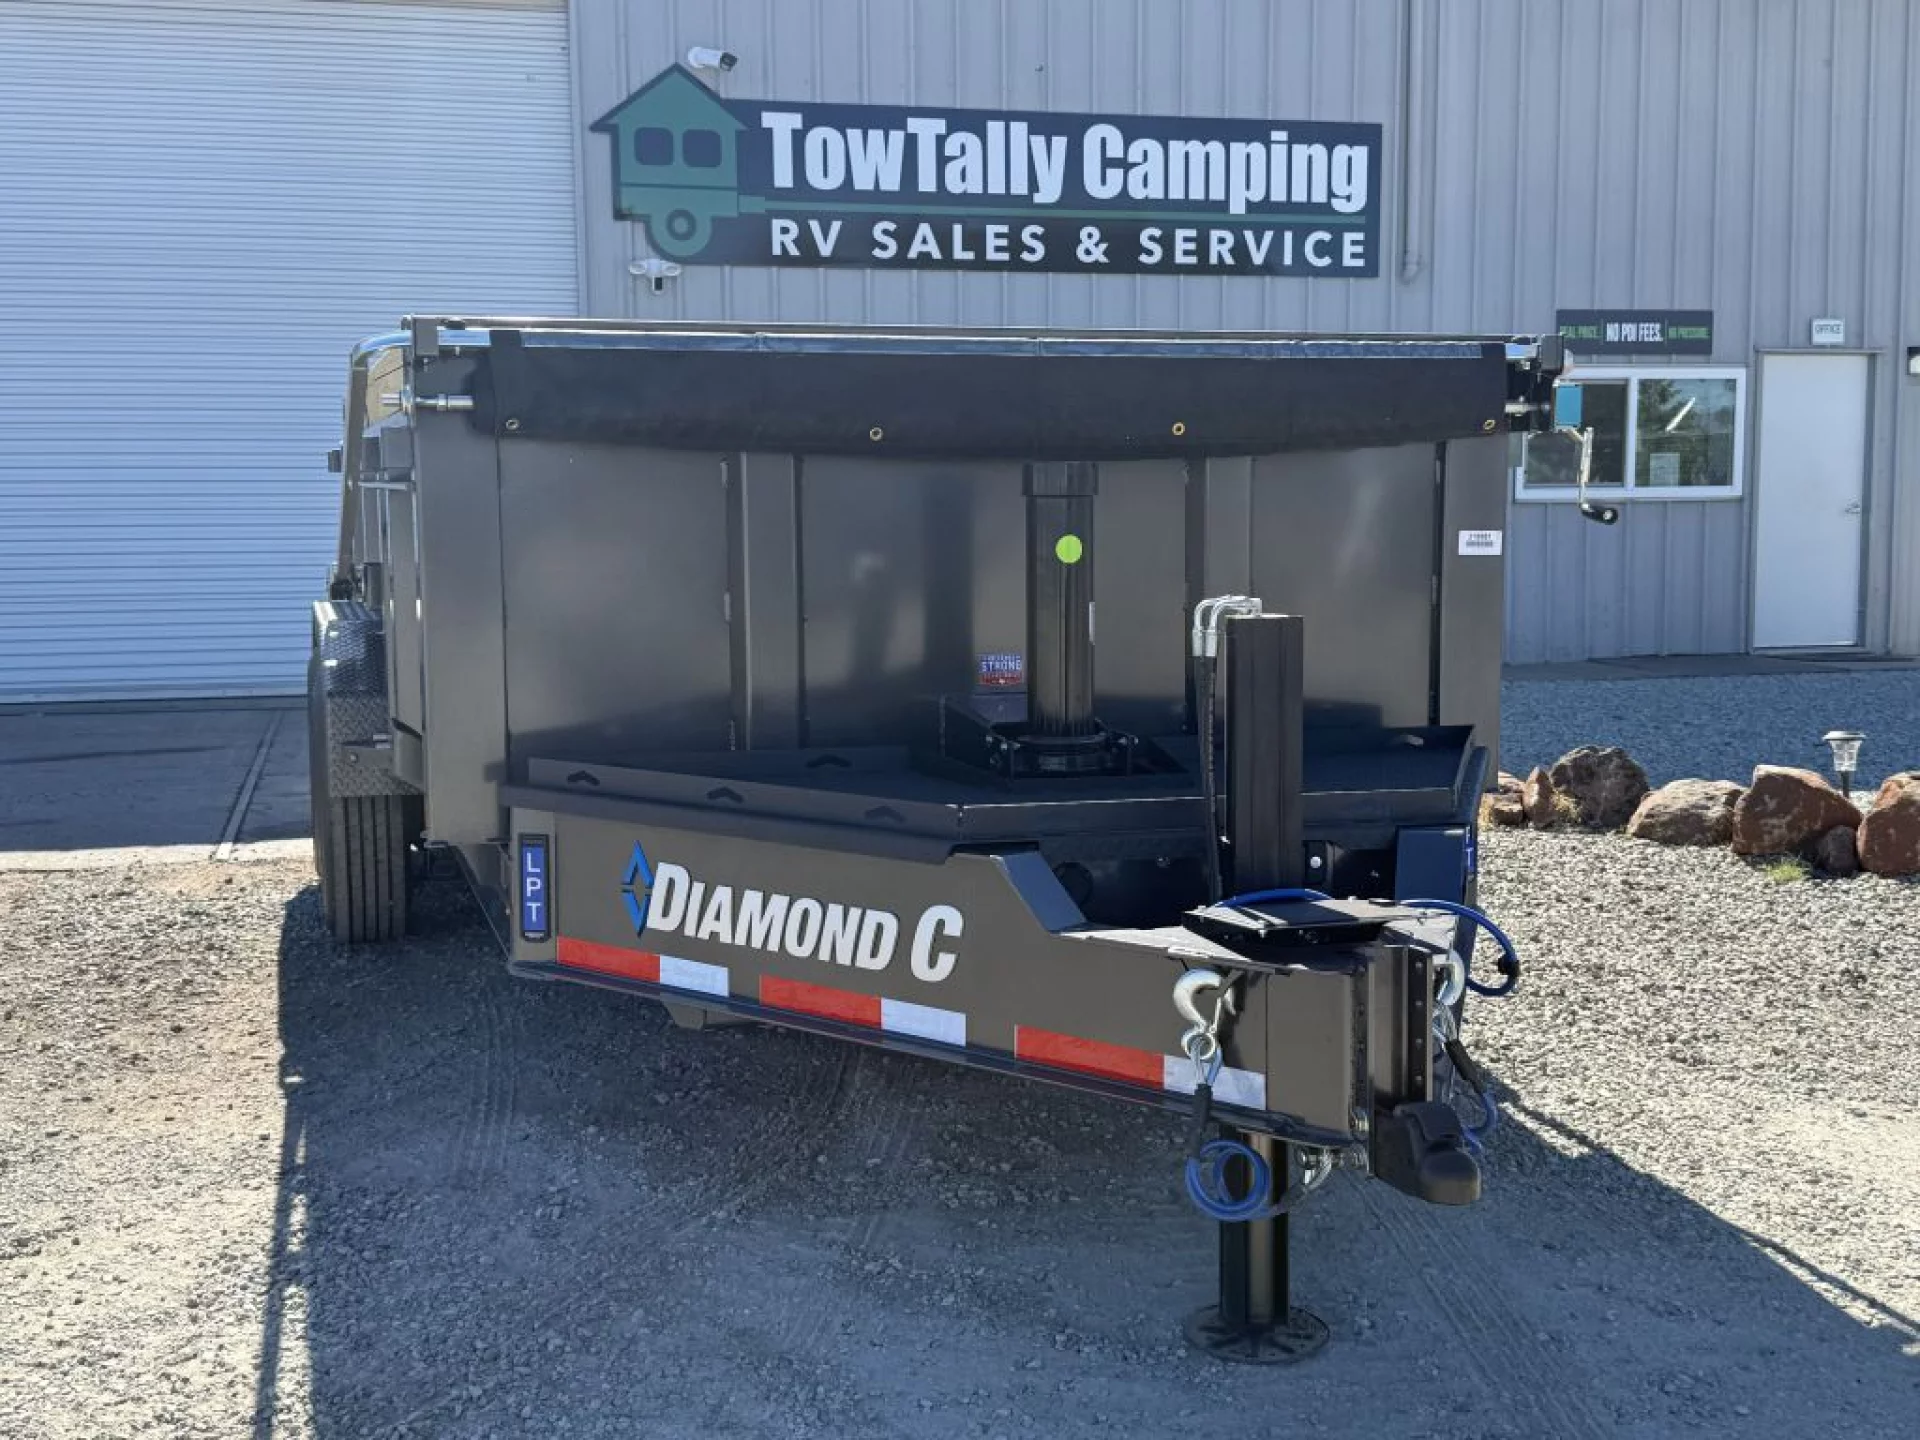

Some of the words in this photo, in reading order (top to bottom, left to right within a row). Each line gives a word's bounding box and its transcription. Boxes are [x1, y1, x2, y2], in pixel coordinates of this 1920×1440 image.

[760, 111, 1067, 203] TowTally
[1083, 123, 1369, 214] Camping
[771, 218, 842, 257] RV
[872, 220, 1045, 262] SALES
[1076, 226, 1110, 263] &
[1138, 227, 1365, 267] SERVICE
[1606, 322, 1619, 341] NO
[1814, 323, 1841, 333] OFFICE
[525, 850, 541, 922] LPT
[646, 861, 899, 971] DIAMOND
[911, 905, 964, 982] C
